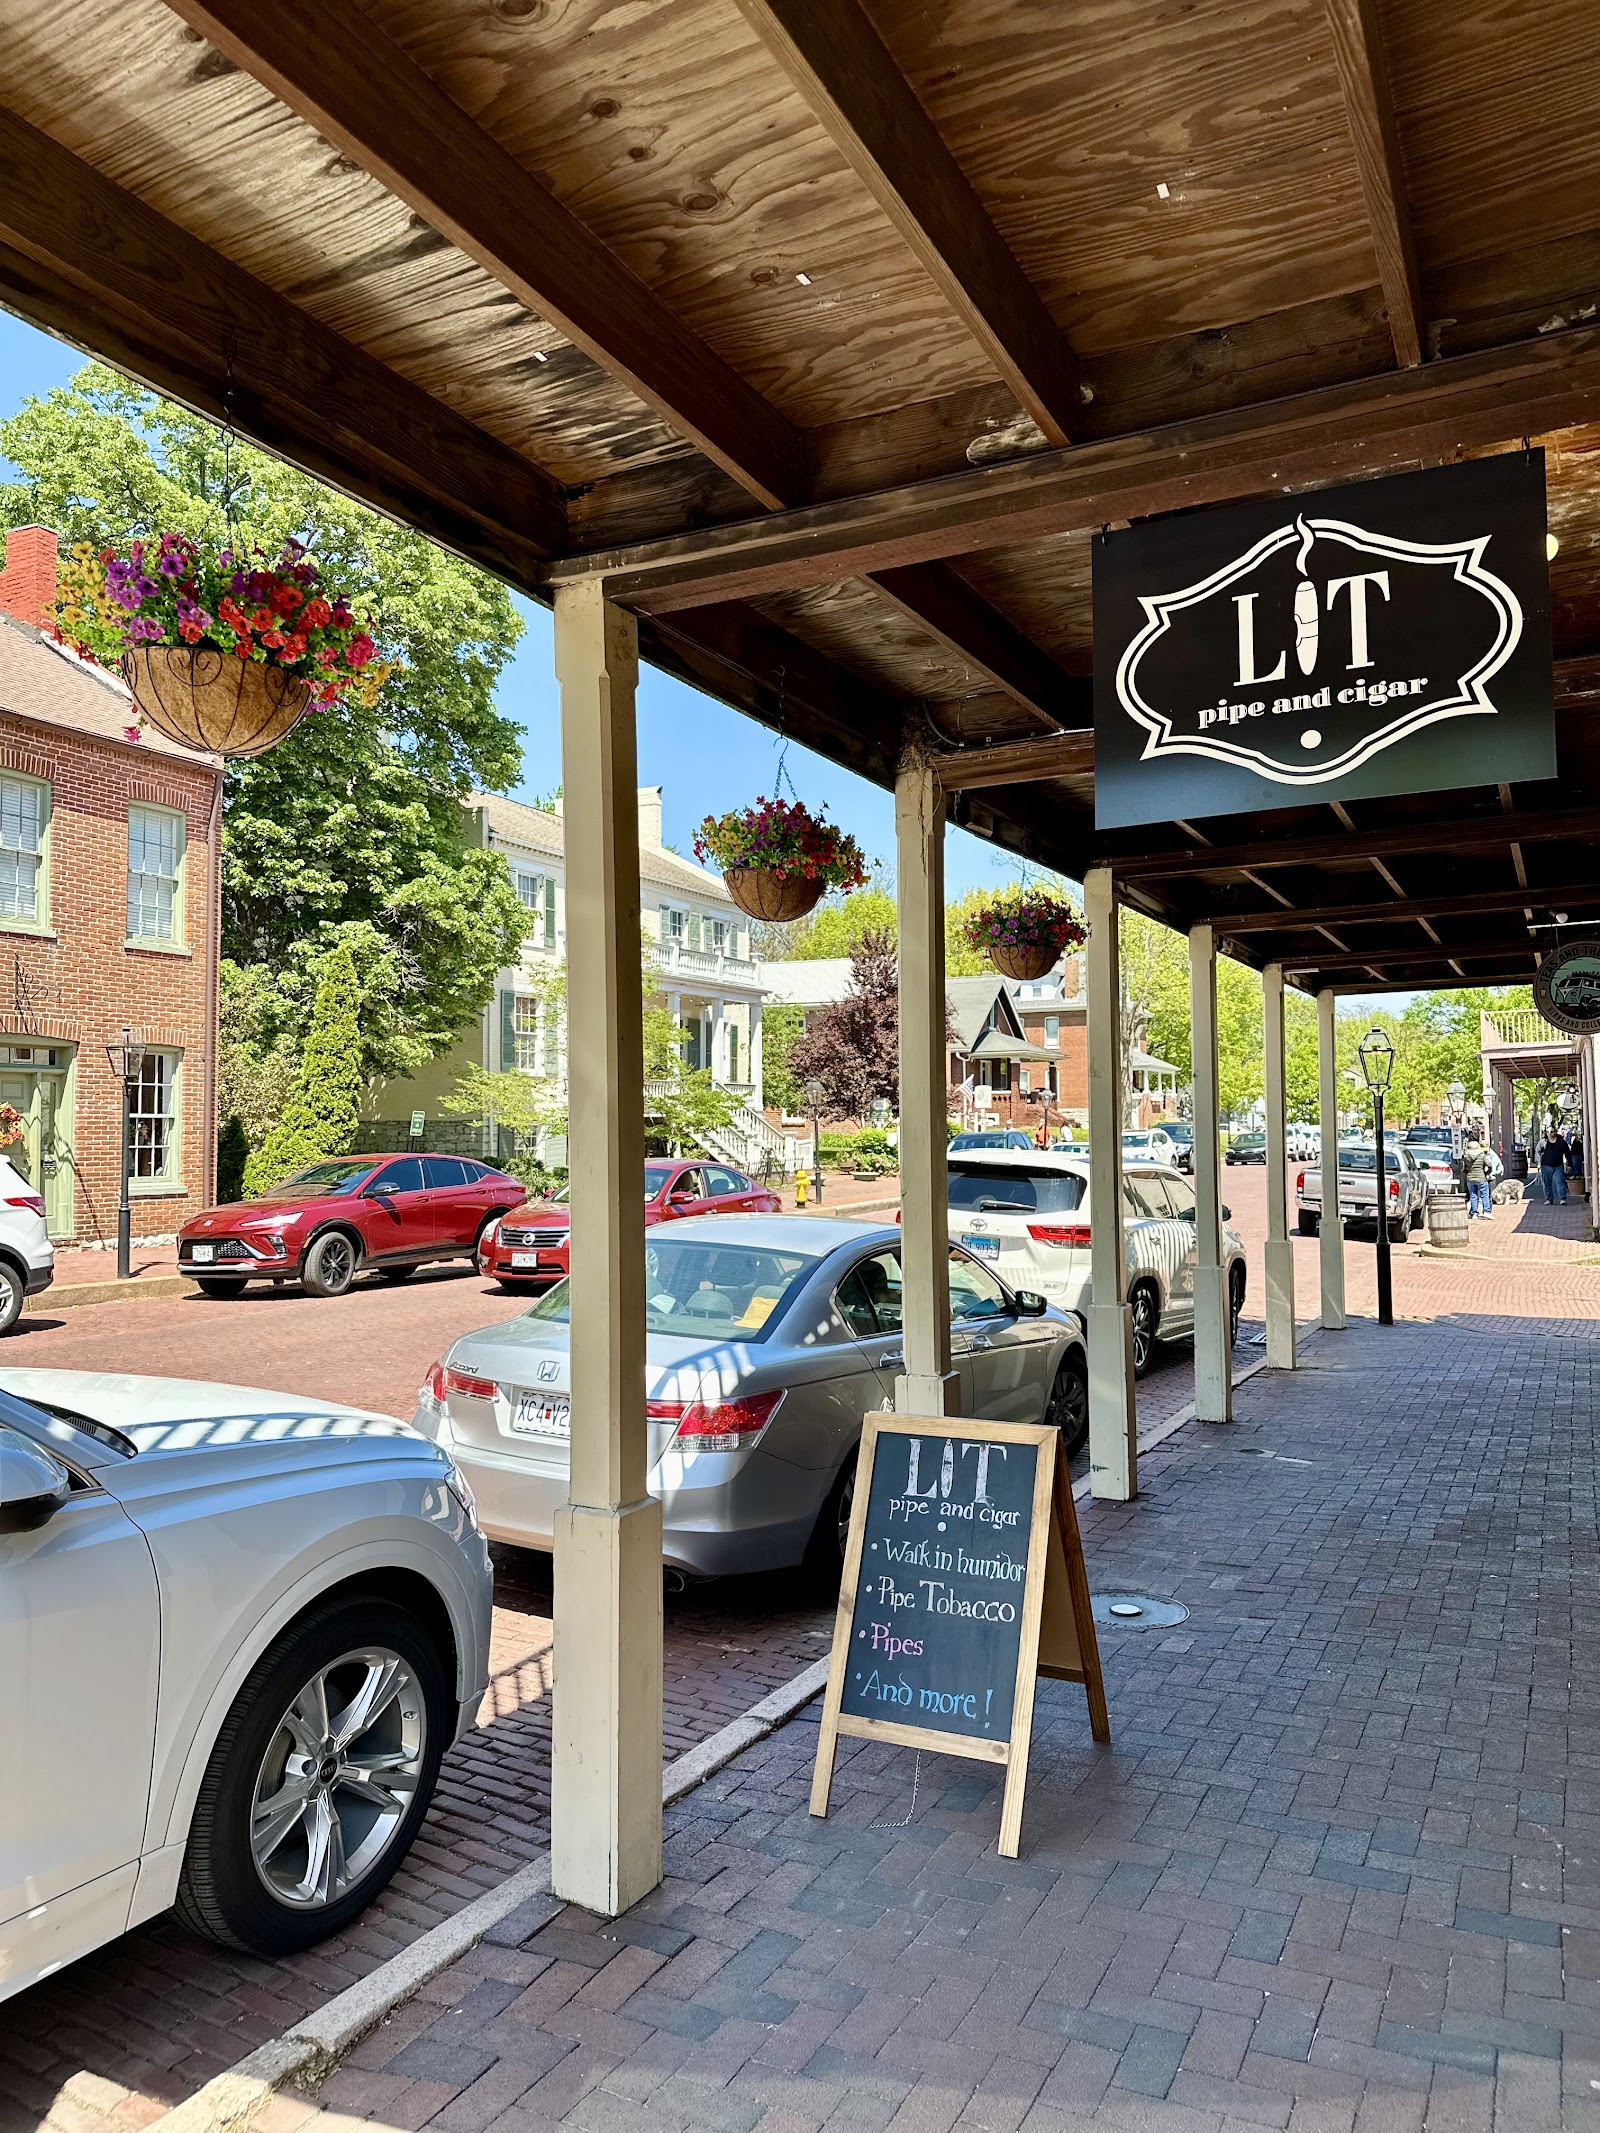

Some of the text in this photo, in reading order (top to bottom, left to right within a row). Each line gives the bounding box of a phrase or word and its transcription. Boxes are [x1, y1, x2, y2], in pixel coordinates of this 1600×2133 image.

[1231, 570, 1391, 687] LIT
[1197, 676, 1429, 730] pipe and cigar
[1540, 961, 1558, 982] TEAS
[1559, 946, 1579, 961] AND
[1565, 1019, 1580, 1029] AND
[903, 1438, 1007, 1504] LIT
[889, 1496, 1021, 1529] pipe and cigar
[883, 1537, 1027, 1582] Walk in humidor
[878, 1575, 1016, 1622] Pipe Tobacco
[870, 1621, 924, 1661] Pipes
[860, 1669, 913, 1706] And
